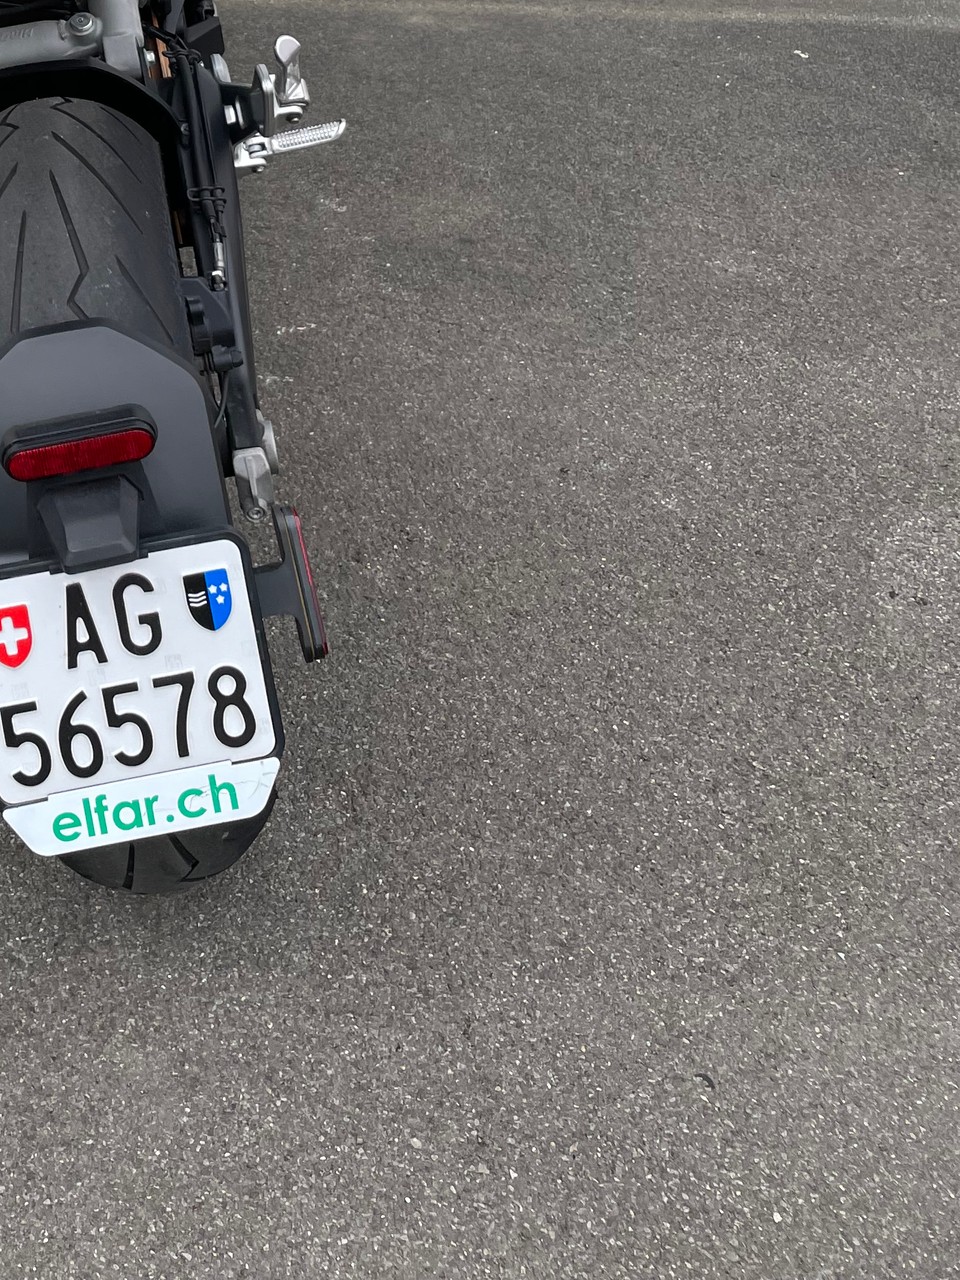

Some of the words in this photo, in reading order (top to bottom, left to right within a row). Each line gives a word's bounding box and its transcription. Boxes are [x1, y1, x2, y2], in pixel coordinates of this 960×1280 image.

[65, 572, 163, 669] AG
[0, 665, 257, 787] 56578
[52, 774, 240, 842] elfar.ch
